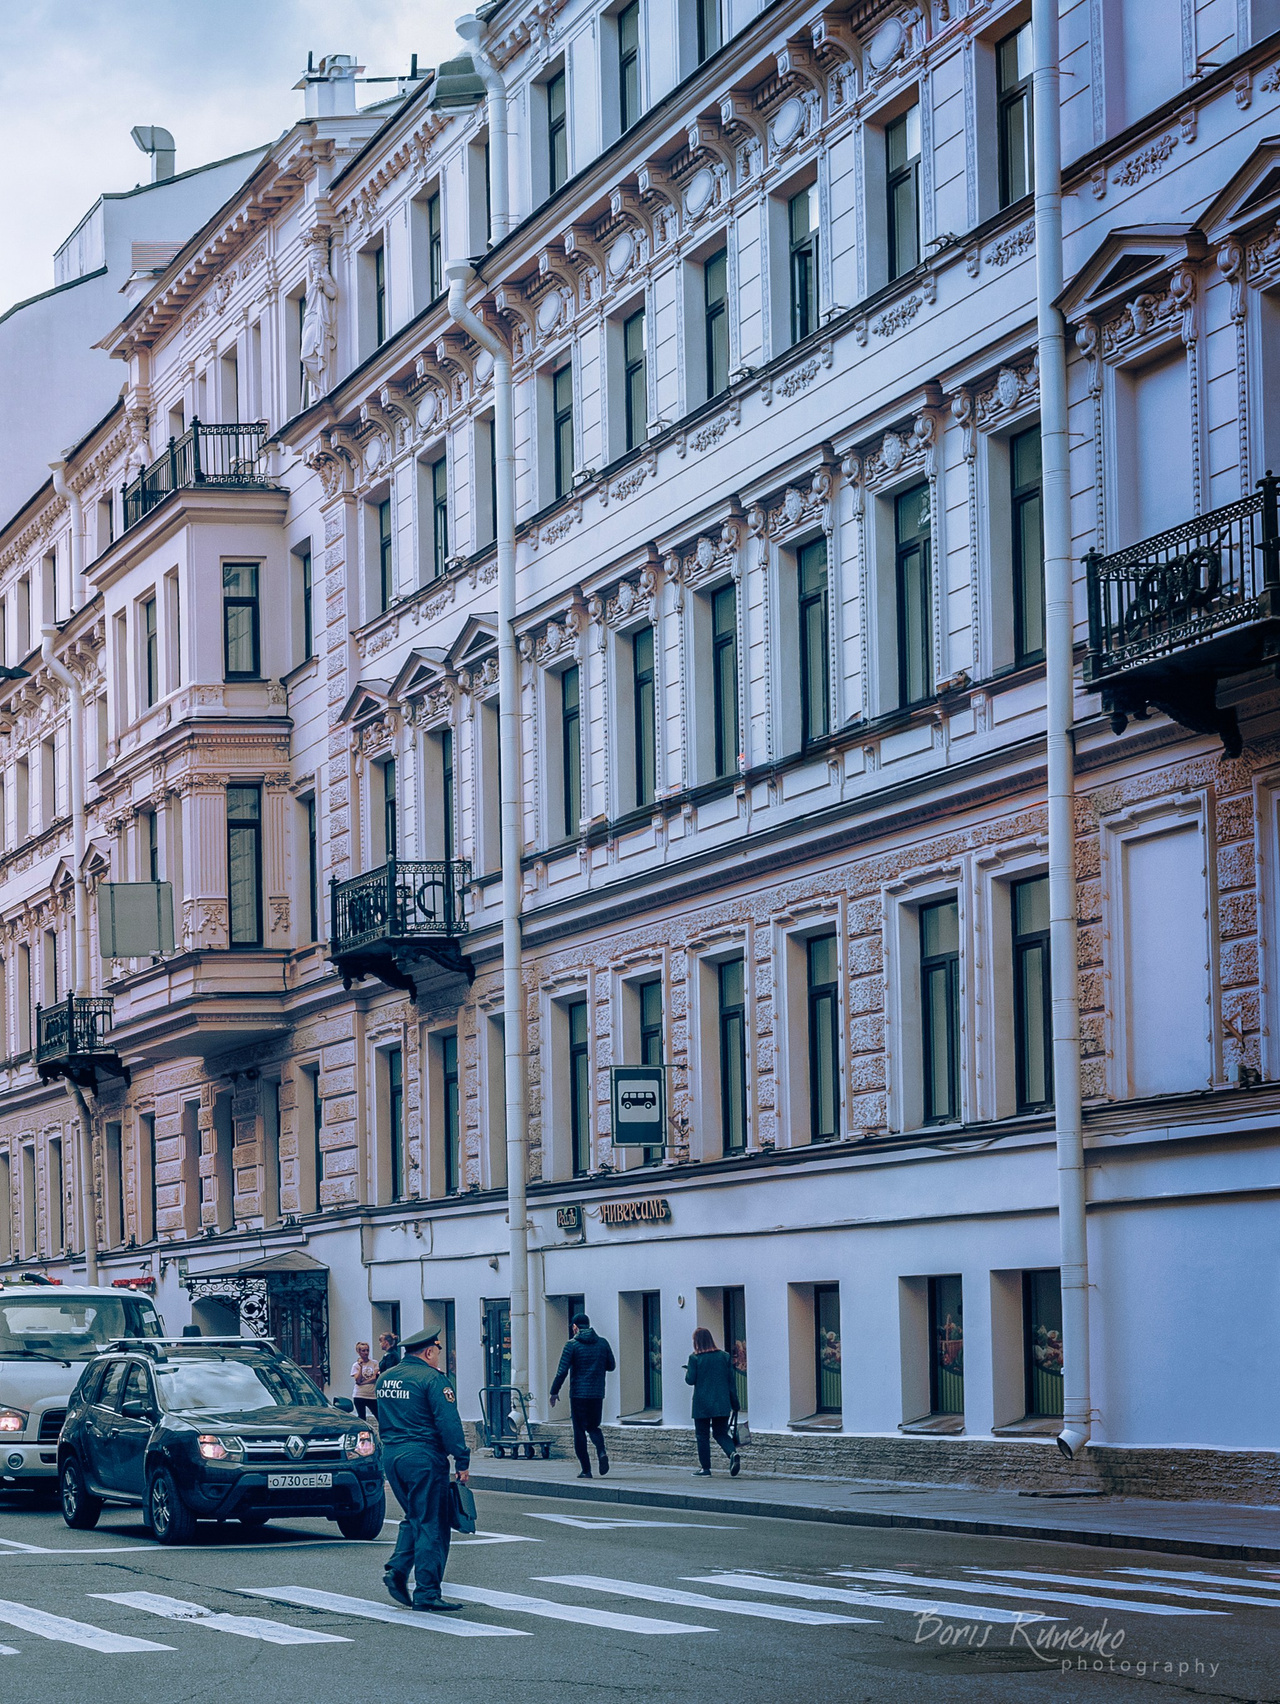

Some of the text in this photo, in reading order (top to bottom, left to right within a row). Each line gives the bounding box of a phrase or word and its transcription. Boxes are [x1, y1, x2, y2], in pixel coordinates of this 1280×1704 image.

[382, 1380, 403, 1389] МЧС
[377, 1389, 410, 1399] РОССИИ
[318, 1474, 328, 1483] 47
